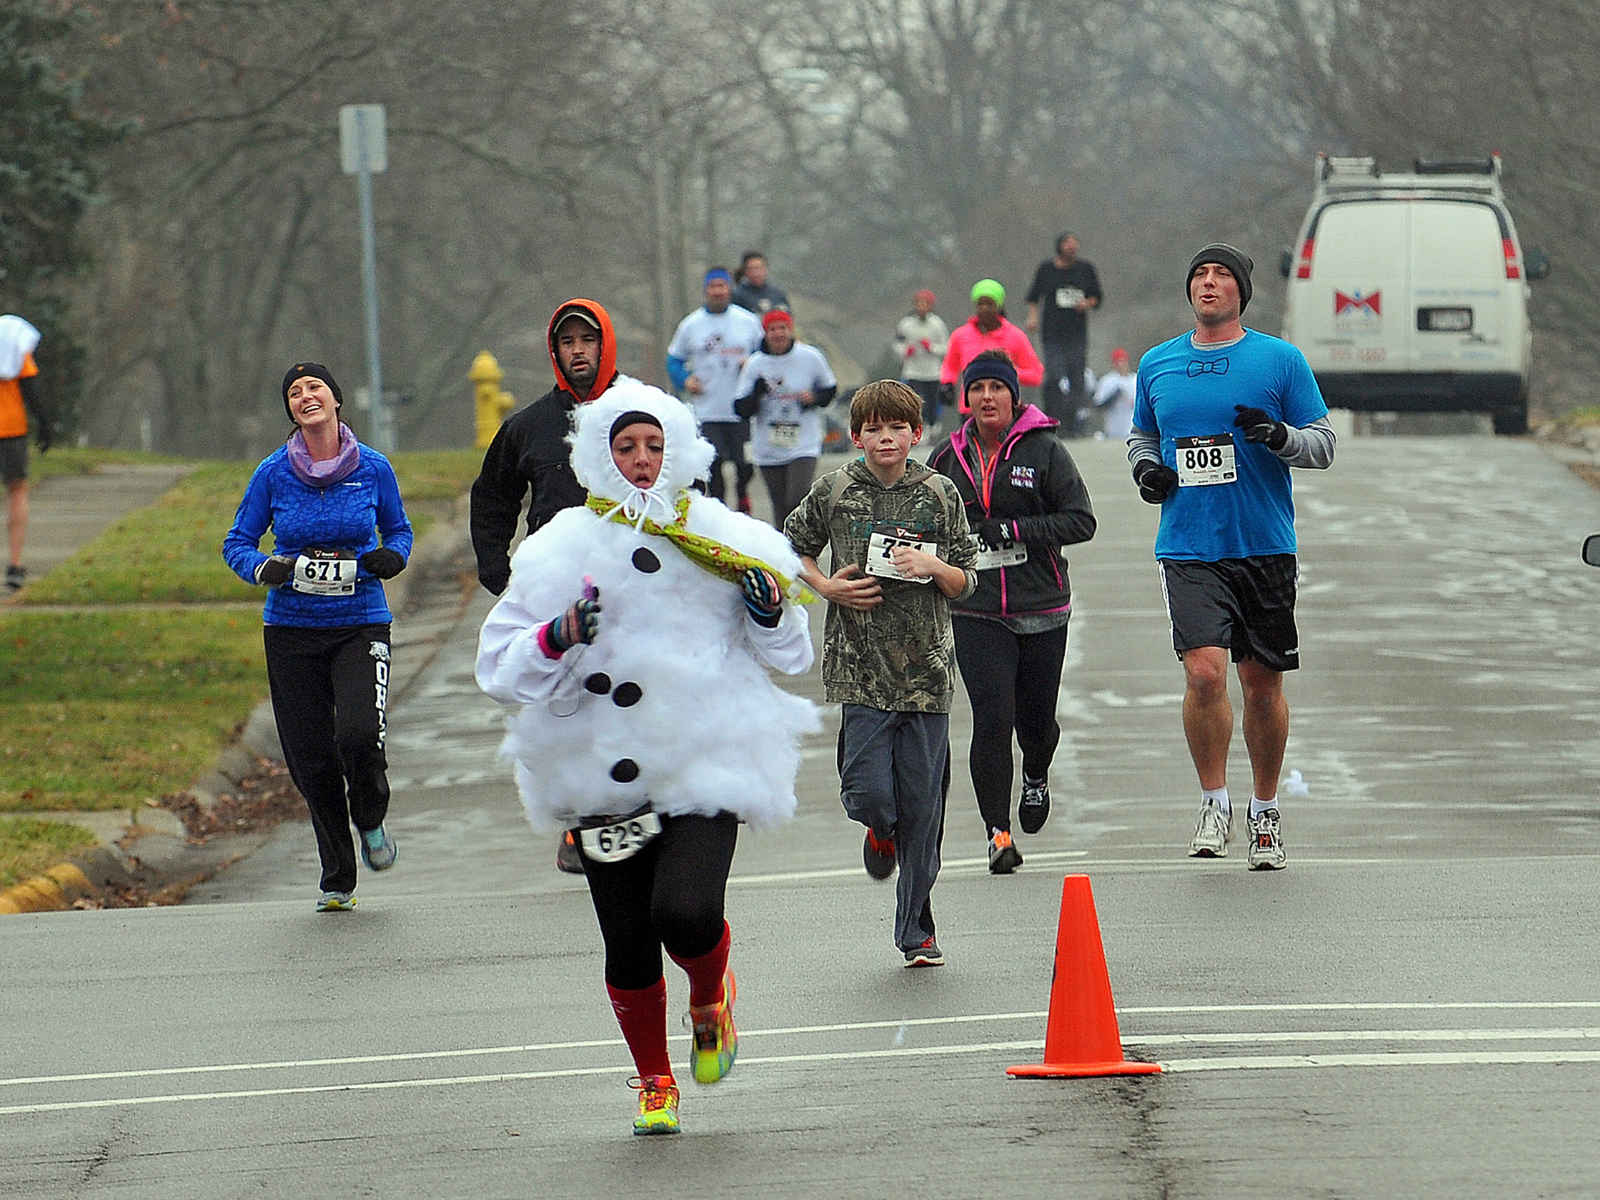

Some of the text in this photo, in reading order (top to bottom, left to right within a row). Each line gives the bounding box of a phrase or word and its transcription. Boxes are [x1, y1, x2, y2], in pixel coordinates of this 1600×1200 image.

[1185, 448, 1223, 469] 808
[1011, 465, 1036, 479] HOT
[304, 561, 342, 581] 671
